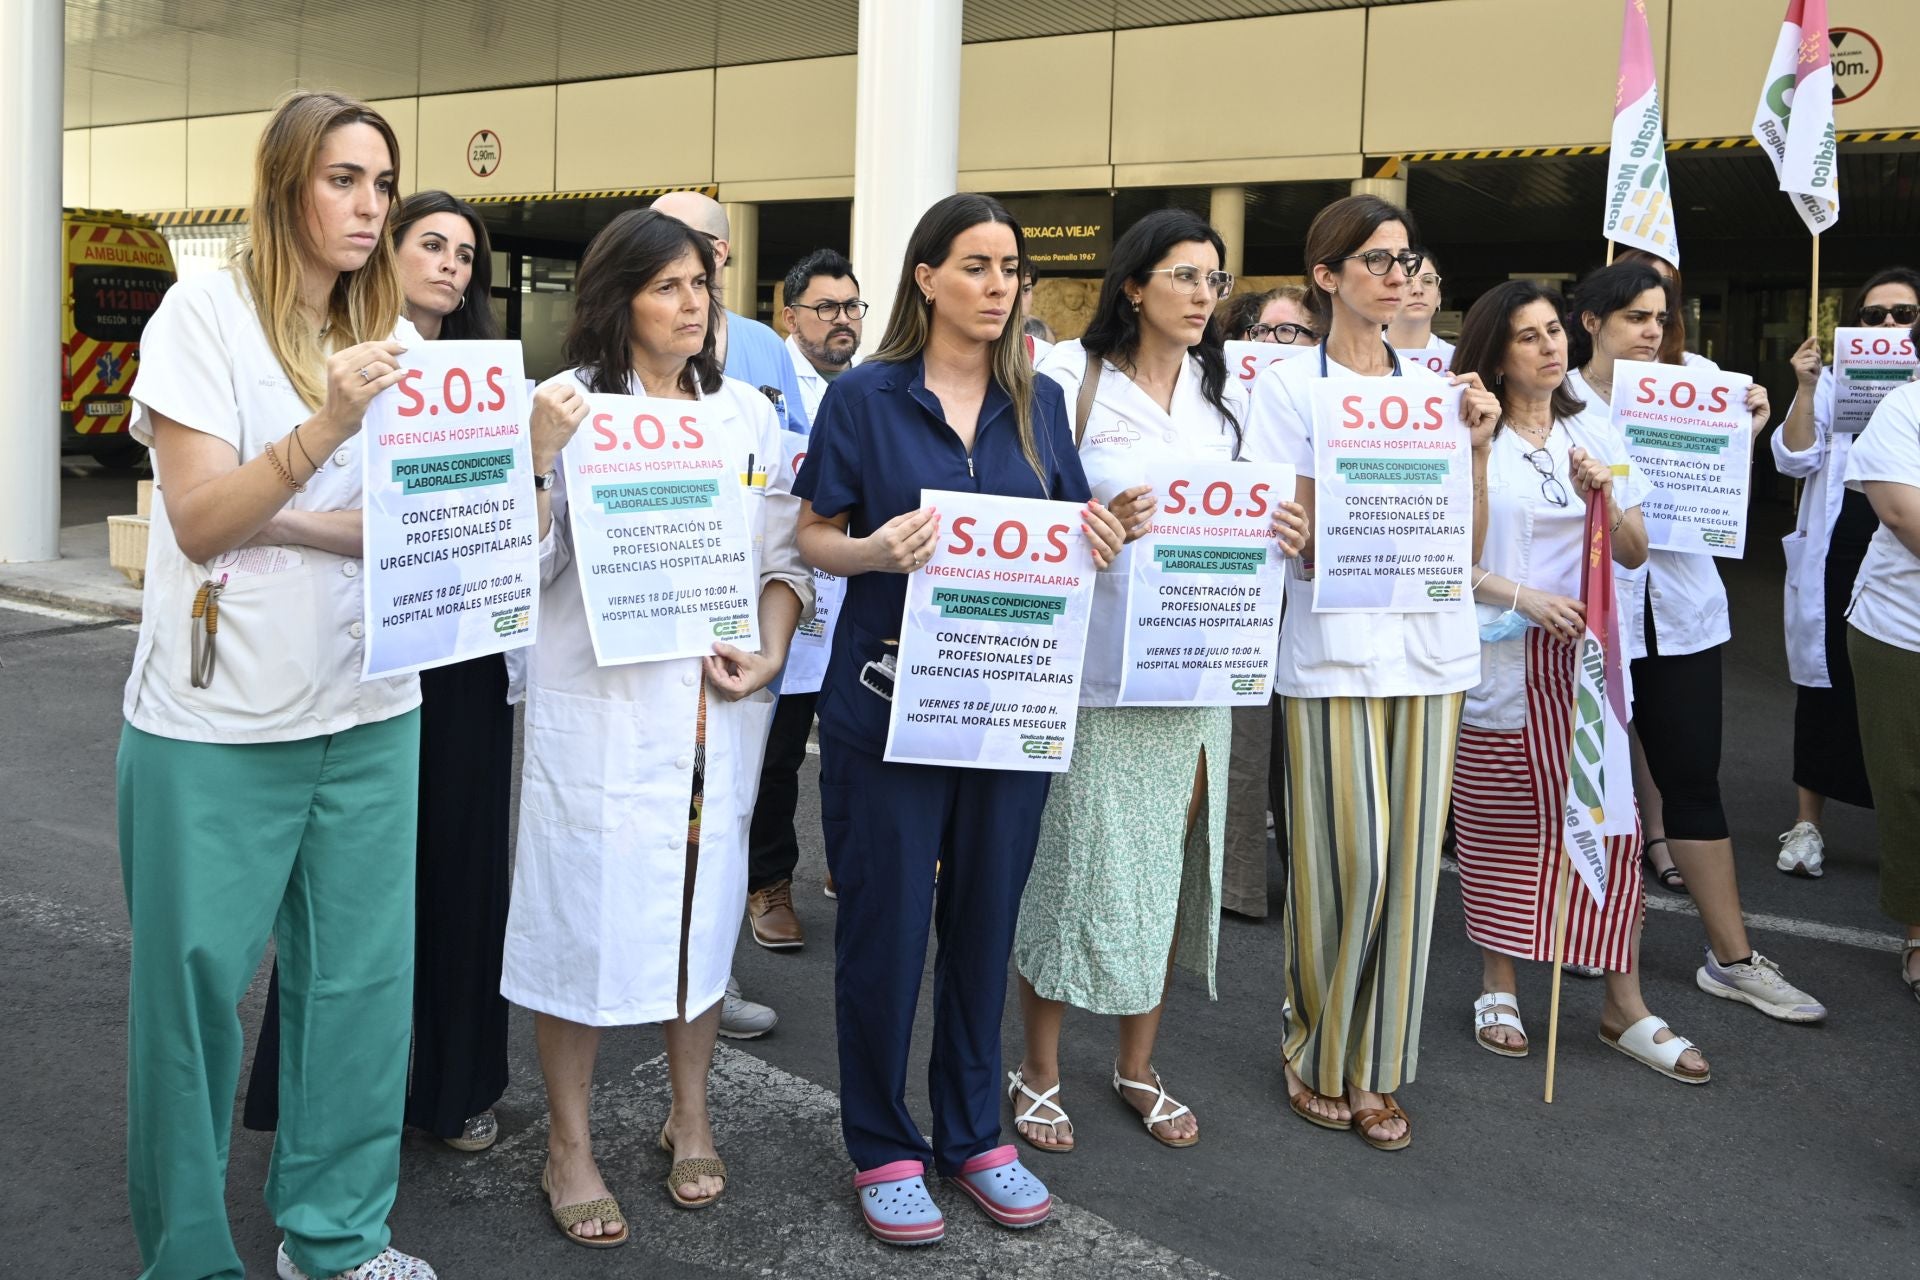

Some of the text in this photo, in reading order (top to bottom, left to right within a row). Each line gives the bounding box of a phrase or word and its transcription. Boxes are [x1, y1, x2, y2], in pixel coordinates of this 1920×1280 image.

[1831, 60, 1869, 76] 0m.
[1800, 193, 1826, 224] urcia
[1021, 226, 1064, 238] RIXACA
[84, 246, 166, 267] AMBULANCIA
[1080, 253, 1096, 261] 1967
[398, 366, 505, 416] S.O.S
[1636, 378, 1729, 413] S.O.S
[1342, 395, 1443, 430] S.O.S
[379, 424, 518, 445] URGENCIAS HOSPITALARIAS
[592, 414, 704, 451] S.O.S
[1328, 440, 1455, 449] URGENCIAS HOSPITALARIAS
[397, 455, 510, 475] POR UNAS CONDICIONES
[579, 460, 722, 474] URGENCIAS HOSPITALARIAS
[408, 469, 503, 488] LABORALES JUSTAS
[1640, 468, 1706, 480] OFESIONALES
[597, 484, 714, 498] POR UNAS CONDICIONES
[1667, 483, 1740, 495] HOSPITALARIAS
[608, 495, 707, 508] LABORALES JUSTAS
[1164, 480, 1270, 517] S.O.S
[1346, 495, 1432, 504] CONCENTRACIÓN
[402, 499, 514, 524] CONCENTRACIÓN DE
[1674, 505, 1697, 513] JULIO
[1653, 513, 1692, 522] MORALES
[1694, 515, 1737, 526] MESEGUER
[407, 519, 510, 545] PROFESIONALES DE
[607, 520, 722, 538] CONCENTRACIÓN DE
[1204, 528, 1276, 537] HOSPITALARIAS
[1389, 526, 1464, 534] HOSPITALARIAS
[613, 538, 720, 555] PROFESIONALES DE
[947, 517, 1070, 563] S.O.S
[381, 535, 531, 569] URGENCIAS HOSPITALARIAS
[1178, 550, 1201, 558] UNAS
[1204, 551, 1262, 560] CONDICIONES
[1397, 555, 1420, 564] JULIO
[592, 552, 744, 574] URGENCIAS HOSPITALARIAS
[1166, 560, 1253, 570] LABORALES JUSTAS
[925, 565, 1078, 586] URGENCIAS HOSPITALARIAS
[393, 573, 522, 606] VIERNES 18 DE JULIO 10:00 H.
[608, 585, 737, 605] VIERNES 18 DE JULIO 10:00 H.
[1160, 585, 1260, 596] CONCENTRACIÓN DE
[383, 588, 530, 627] HOSPITAL MORALES MESEGUER
[937, 593, 1060, 609] POR UNAS CONDICIONES
[1162, 602, 1255, 611] PROFESIONALES DE
[602, 599, 748, 620] HOSPITAL MORALES MESEGUER
[946, 605, 1049, 620] LABORALES JUSTAS
[1139, 618, 1272, 626] URGENCIAS HOSPITALARIAS
[937, 632, 1057, 648] CONCENTRACIÓN DE
[939, 650, 1050, 665] PROFESIONALES DE
[1206, 648, 1228, 656] JULIO
[1225, 660, 1267, 668] MESEGUER
[912, 665, 1072, 683] URGENCIAS HOSPITALARIAS
[920, 699, 1057, 714] VIERNES 18 DE JULIO 10:00 H.
[908, 714, 1066, 729] HOSPITAL MORALES MESEGUER
